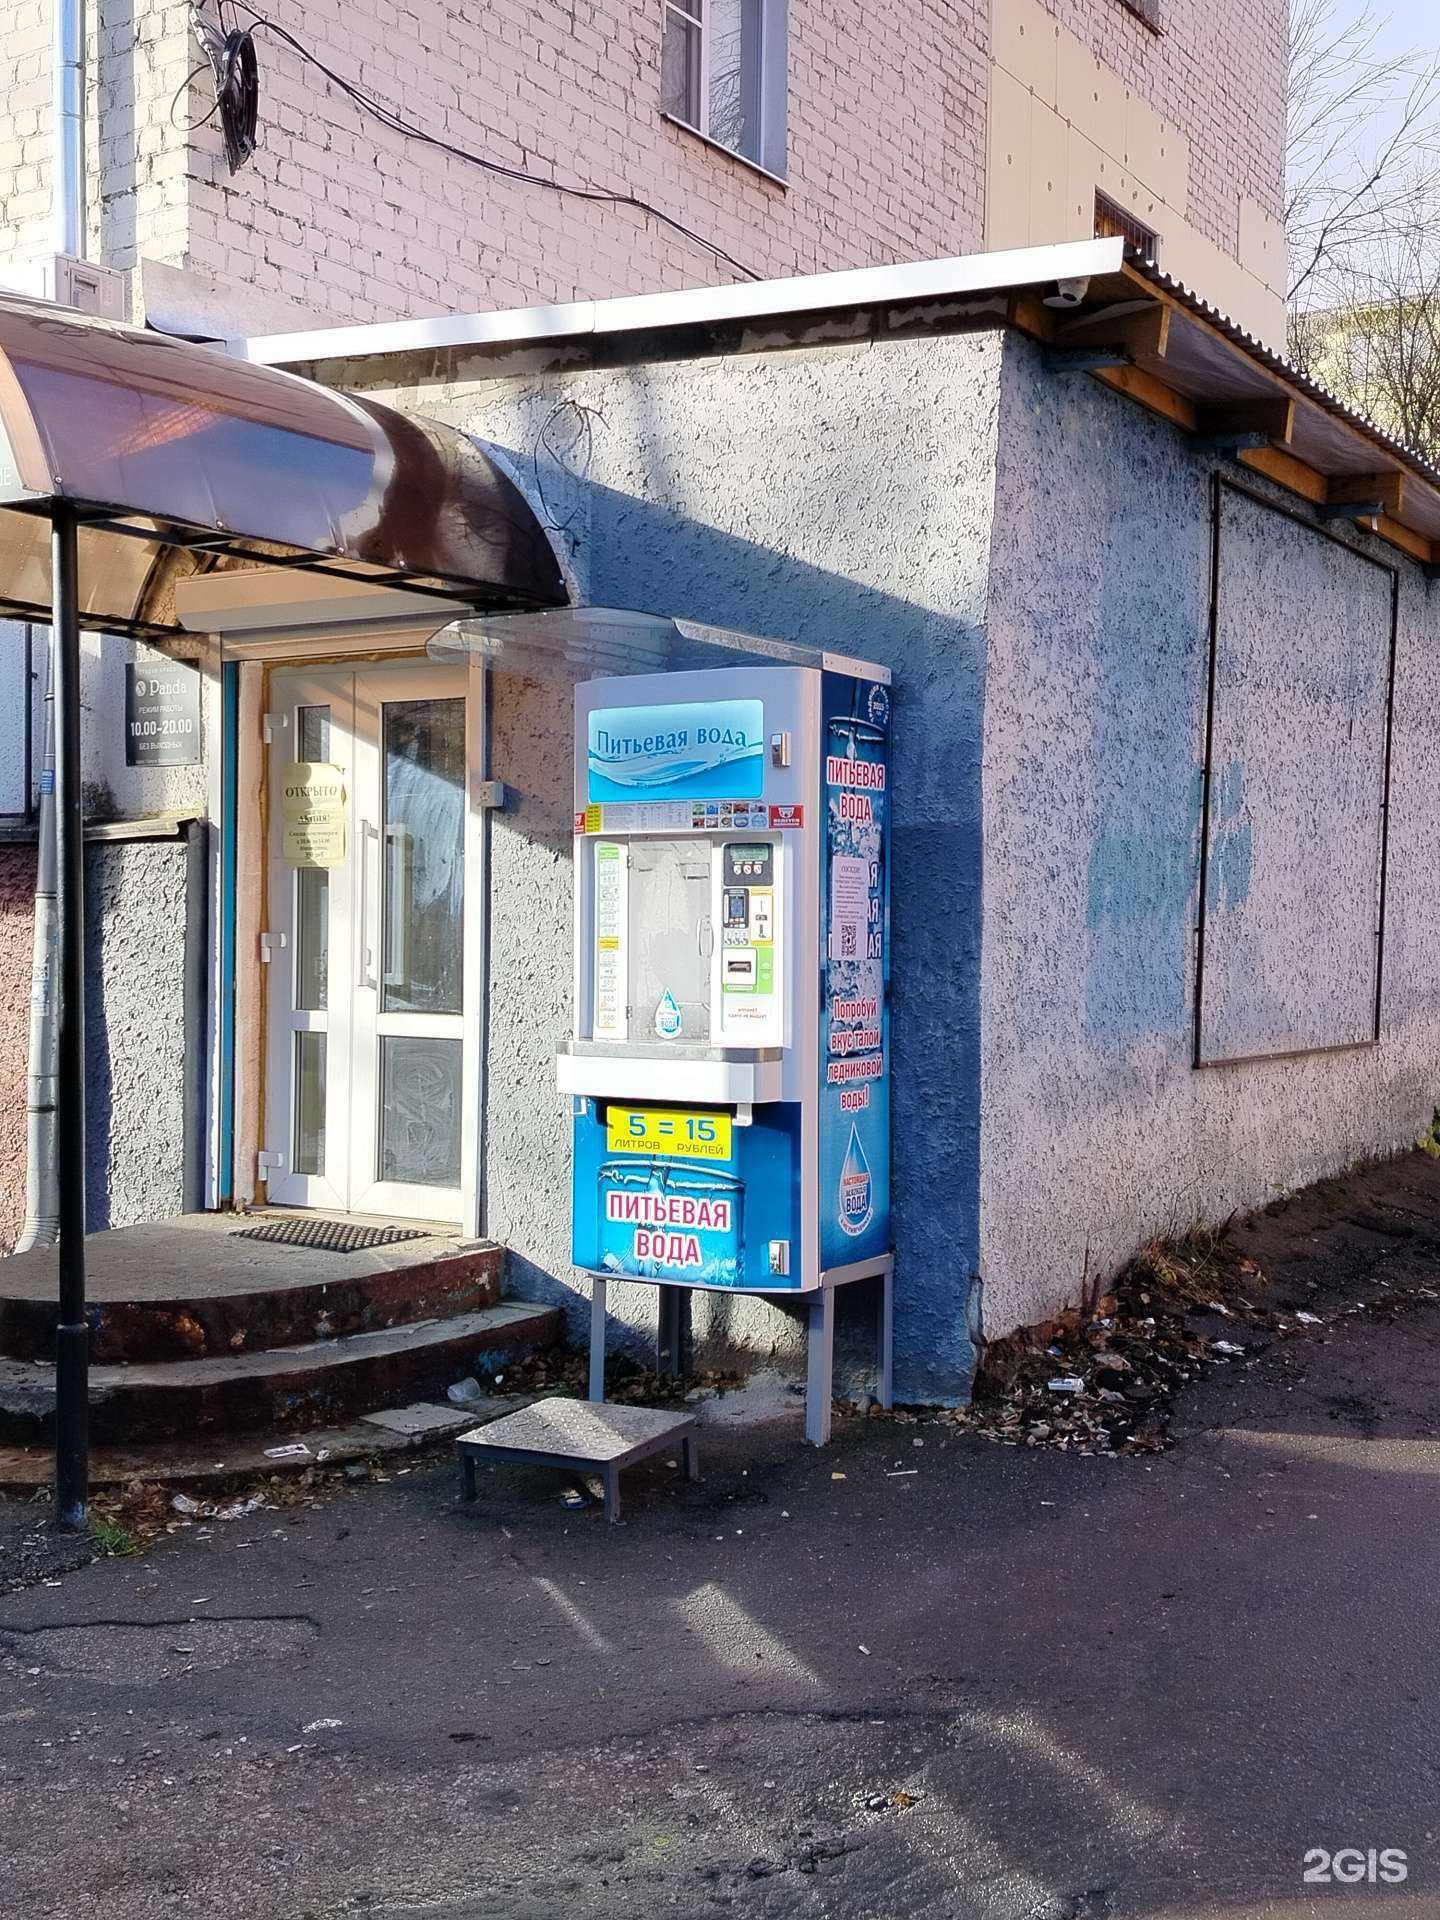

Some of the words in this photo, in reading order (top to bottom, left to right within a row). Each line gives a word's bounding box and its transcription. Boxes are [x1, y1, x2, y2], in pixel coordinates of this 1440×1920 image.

[150, 678, 187, 697] Panda
[130, 719, 192, 736] 10.00-20.00
[598, 730, 688, 754] Питьевая
[697, 727, 746, 747] вода
[829, 759, 884, 789] ПИТЬЕВАЯ
[285, 786, 338, 798] ОТКРЫТО
[841, 795, 871, 823] ВОДА
[834, 997, 877, 1020] Попробуй
[831, 1032, 853, 1054] вкус
[854, 1029, 880, 1048] талой
[828, 1058, 882, 1082] ледниковой
[841, 1086, 869, 1110] воды!
[629, 1115, 646, 1137] 5
[686, 1118, 716, 1141] 15
[614, 1138, 660, 1150] ЛИТРОВ
[677, 1143, 724, 1155] РУБЛЕЙ
[609, 1194, 728, 1228] ПИТЬЕВАЯ
[846, 1194, 867, 1213] ВОДА
[636, 1233, 699, 1265] ВОДА
